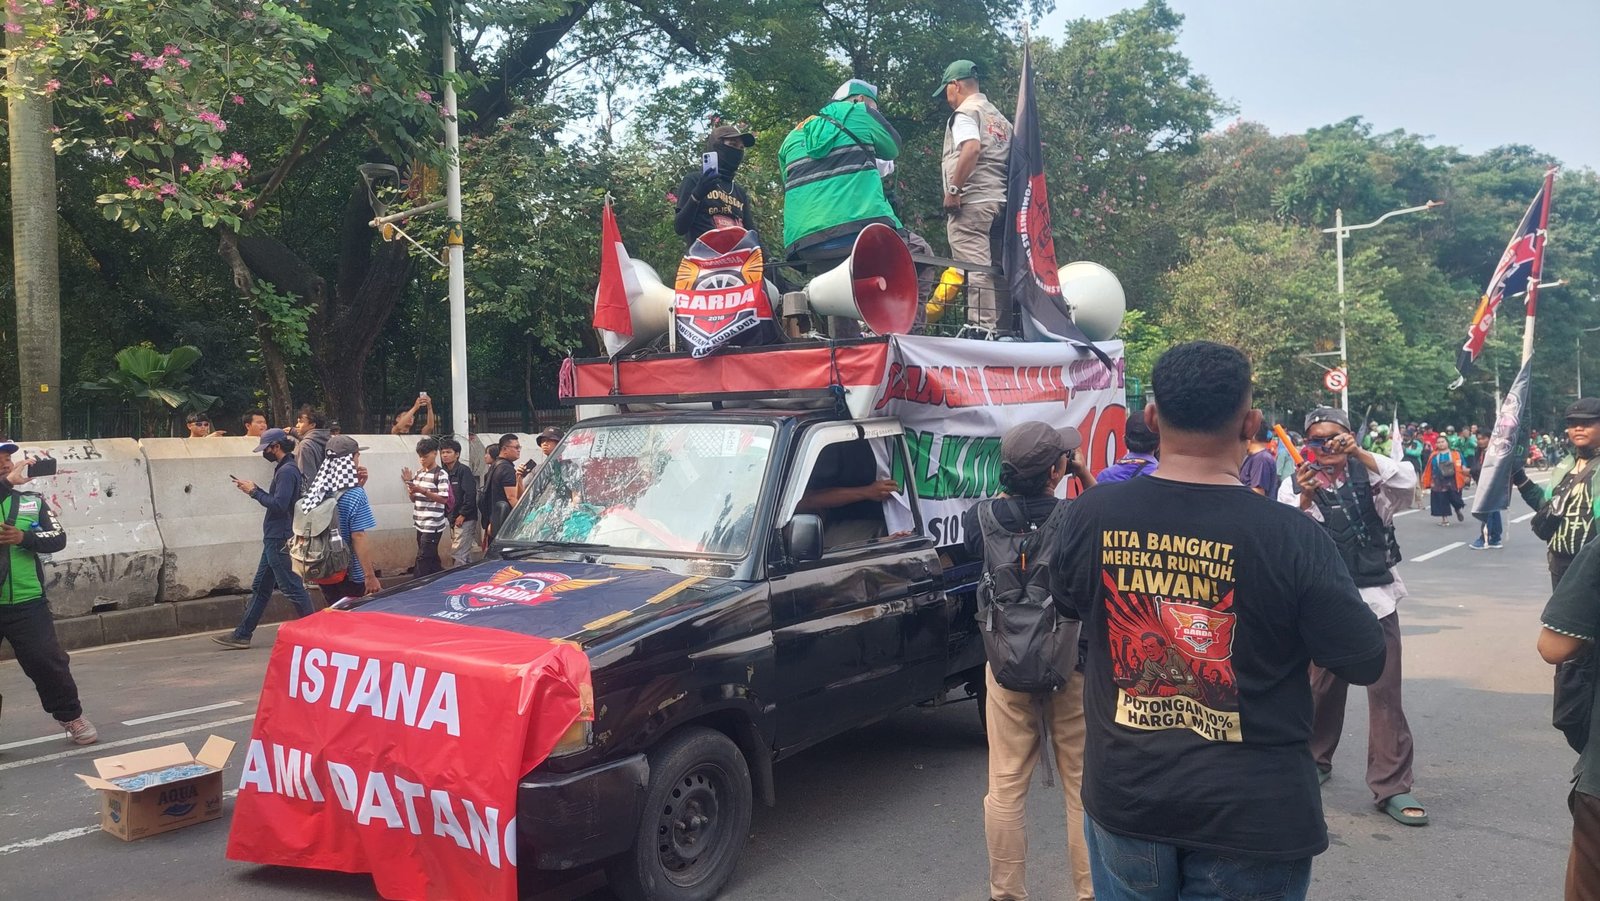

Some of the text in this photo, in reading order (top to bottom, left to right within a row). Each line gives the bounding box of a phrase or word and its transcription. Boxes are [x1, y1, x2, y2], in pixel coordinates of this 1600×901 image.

[675, 288, 756, 311] GARDA
[737, 317, 757, 332] DUA
[1103, 530, 1235, 565] KITA BANGKIT,
[1102, 550, 1236, 583] MEREKA RUNTUH.
[470, 585, 542, 602] GARDA
[1117, 567, 1220, 603] LAWAN!
[1184, 628, 1213, 637] GARDA
[288, 645, 461, 737] ISTANA
[1123, 694, 1233, 729] POTONGAN 10%
[1128, 711, 1228, 741] HARGA MATI
[157, 784, 199, 806] AQUA
